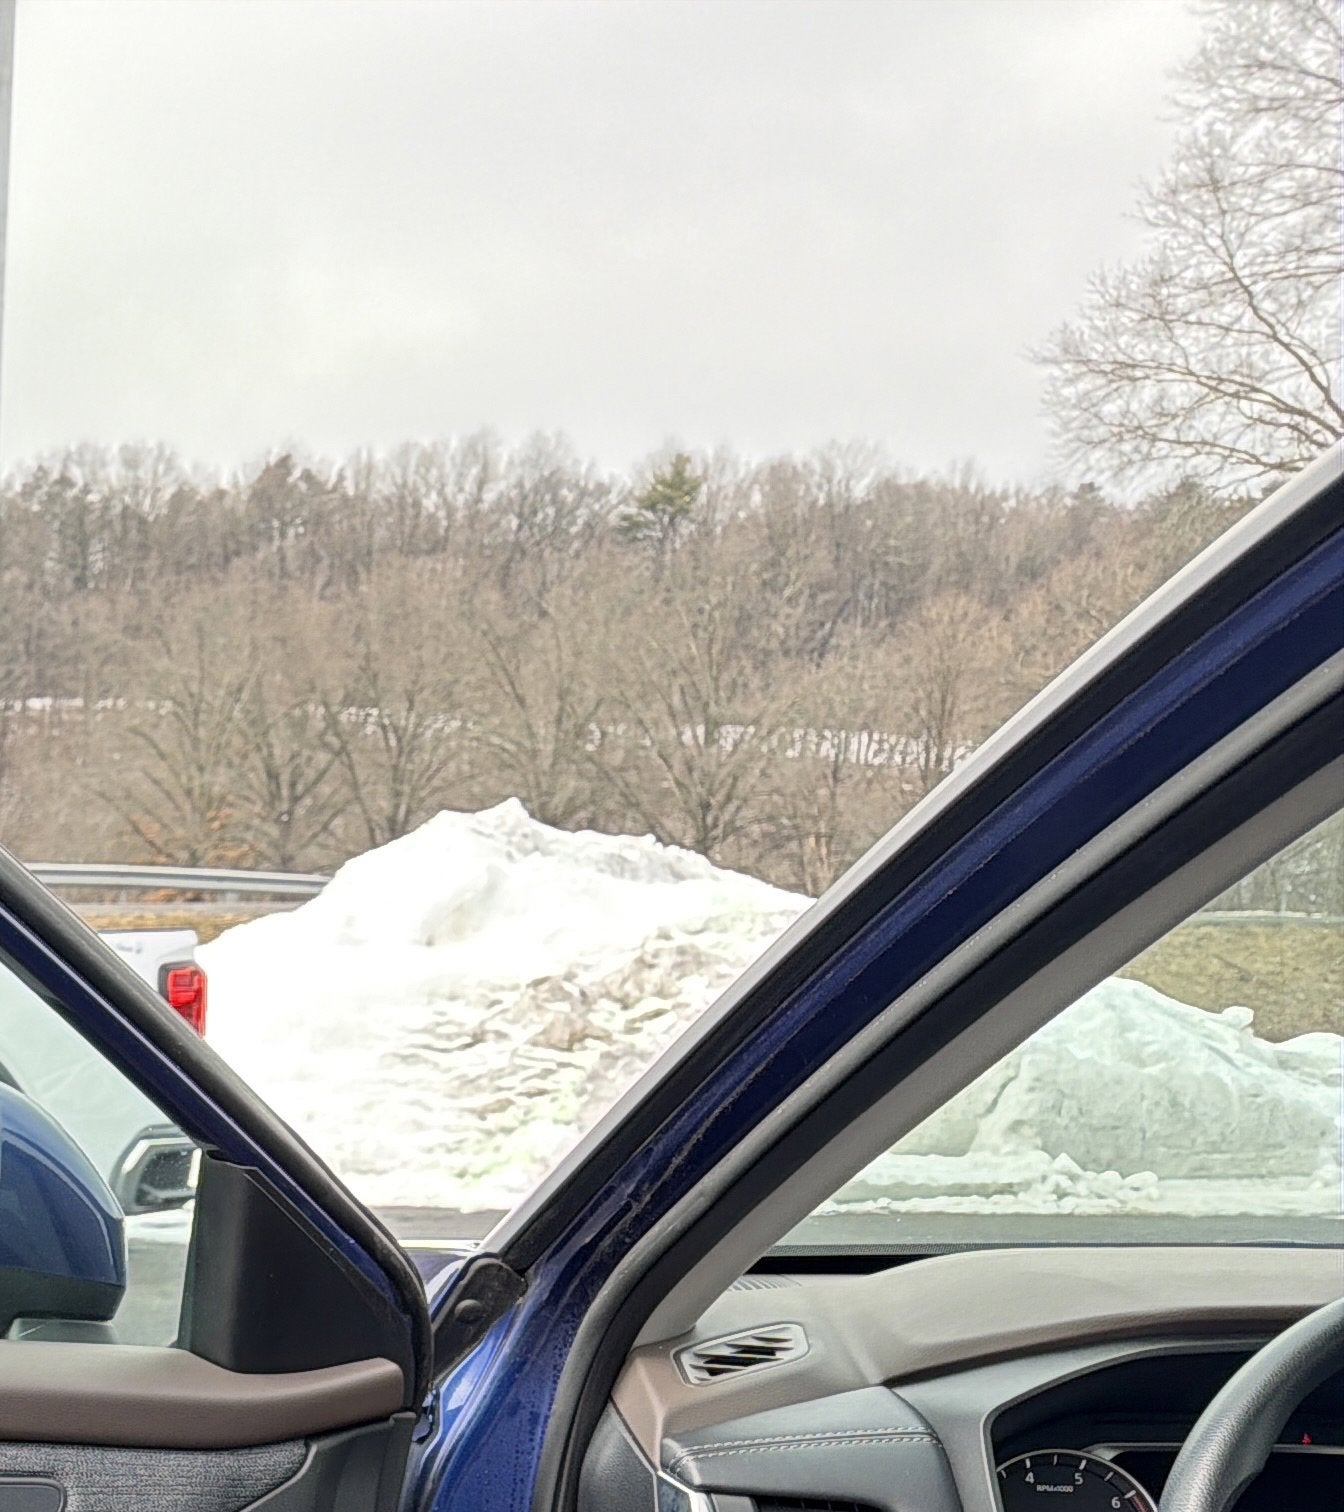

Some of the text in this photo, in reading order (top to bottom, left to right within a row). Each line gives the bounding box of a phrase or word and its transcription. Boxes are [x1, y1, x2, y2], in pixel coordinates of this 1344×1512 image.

[1025, 1472, 1035, 1484] 4
[1074, 1473, 1083, 1485] 5
[1112, 1497, 1121, 1509] 6
